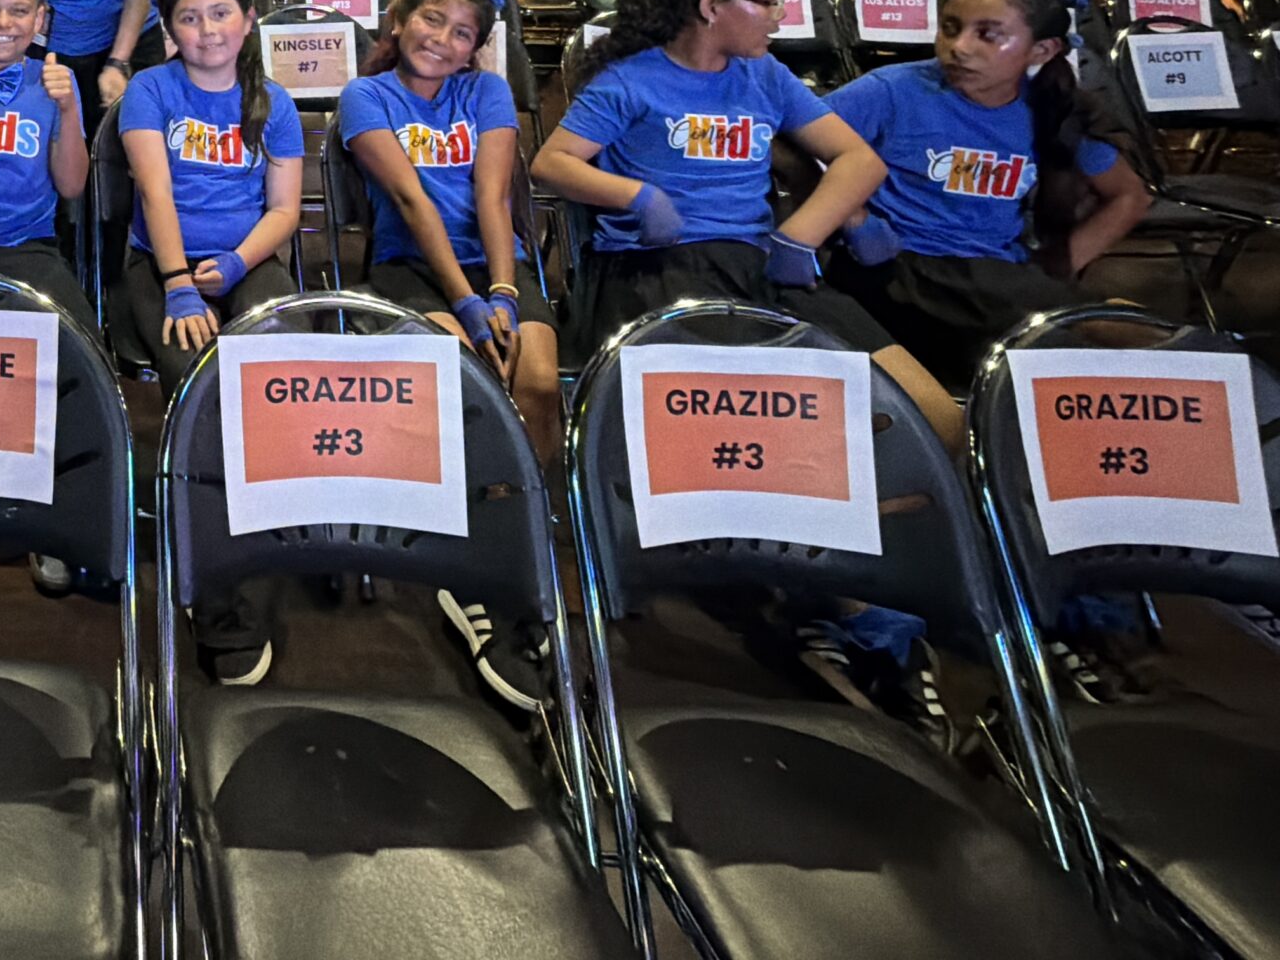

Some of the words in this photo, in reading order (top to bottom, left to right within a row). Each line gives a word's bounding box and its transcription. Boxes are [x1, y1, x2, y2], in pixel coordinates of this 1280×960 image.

[273, 37, 343, 53] KINGSLEY
[1147, 49, 1202, 63] ALCOTT
[297, 60, 319, 73] #7
[1164, 72, 1186, 85] #9
[684, 114, 773, 161] Kids
[264, 376, 414, 405] GRAZIDE
[664, 388, 819, 420] GRAZIDE
[1053, 393, 1203, 424] GRAZIDE
[312, 428, 363, 457] #3
[712, 442, 765, 471] #3
[1098, 446, 1149, 476] #3
